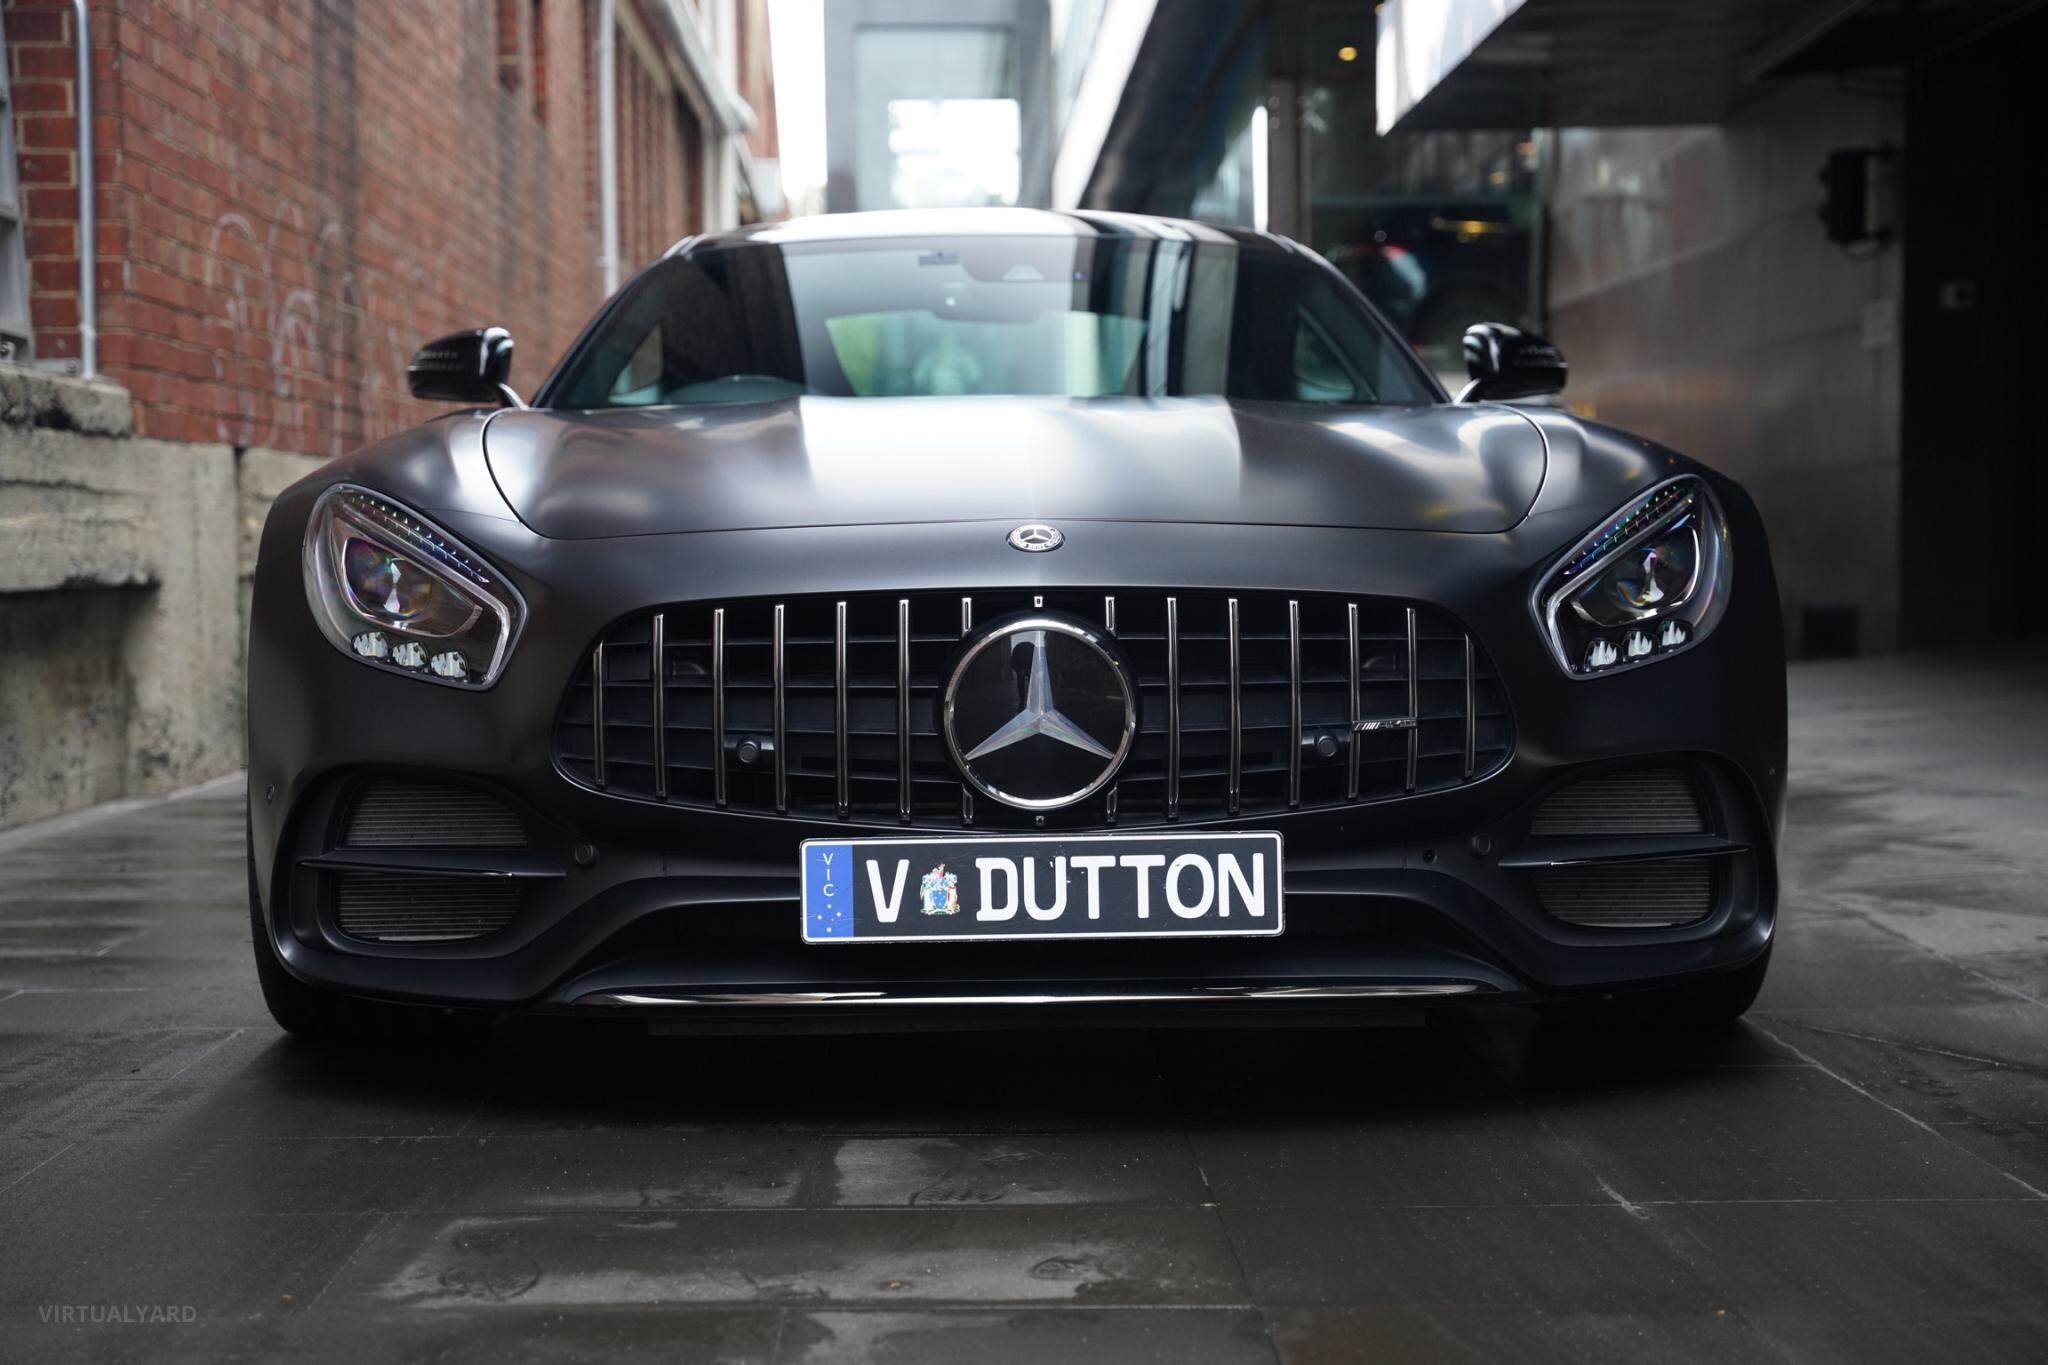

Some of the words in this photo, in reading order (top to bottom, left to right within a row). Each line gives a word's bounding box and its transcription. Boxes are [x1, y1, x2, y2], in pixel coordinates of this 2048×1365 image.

[822, 852, 835, 897] VIC
[866, 859, 910, 923] V
[975, 852, 1266, 921] DUTTON
